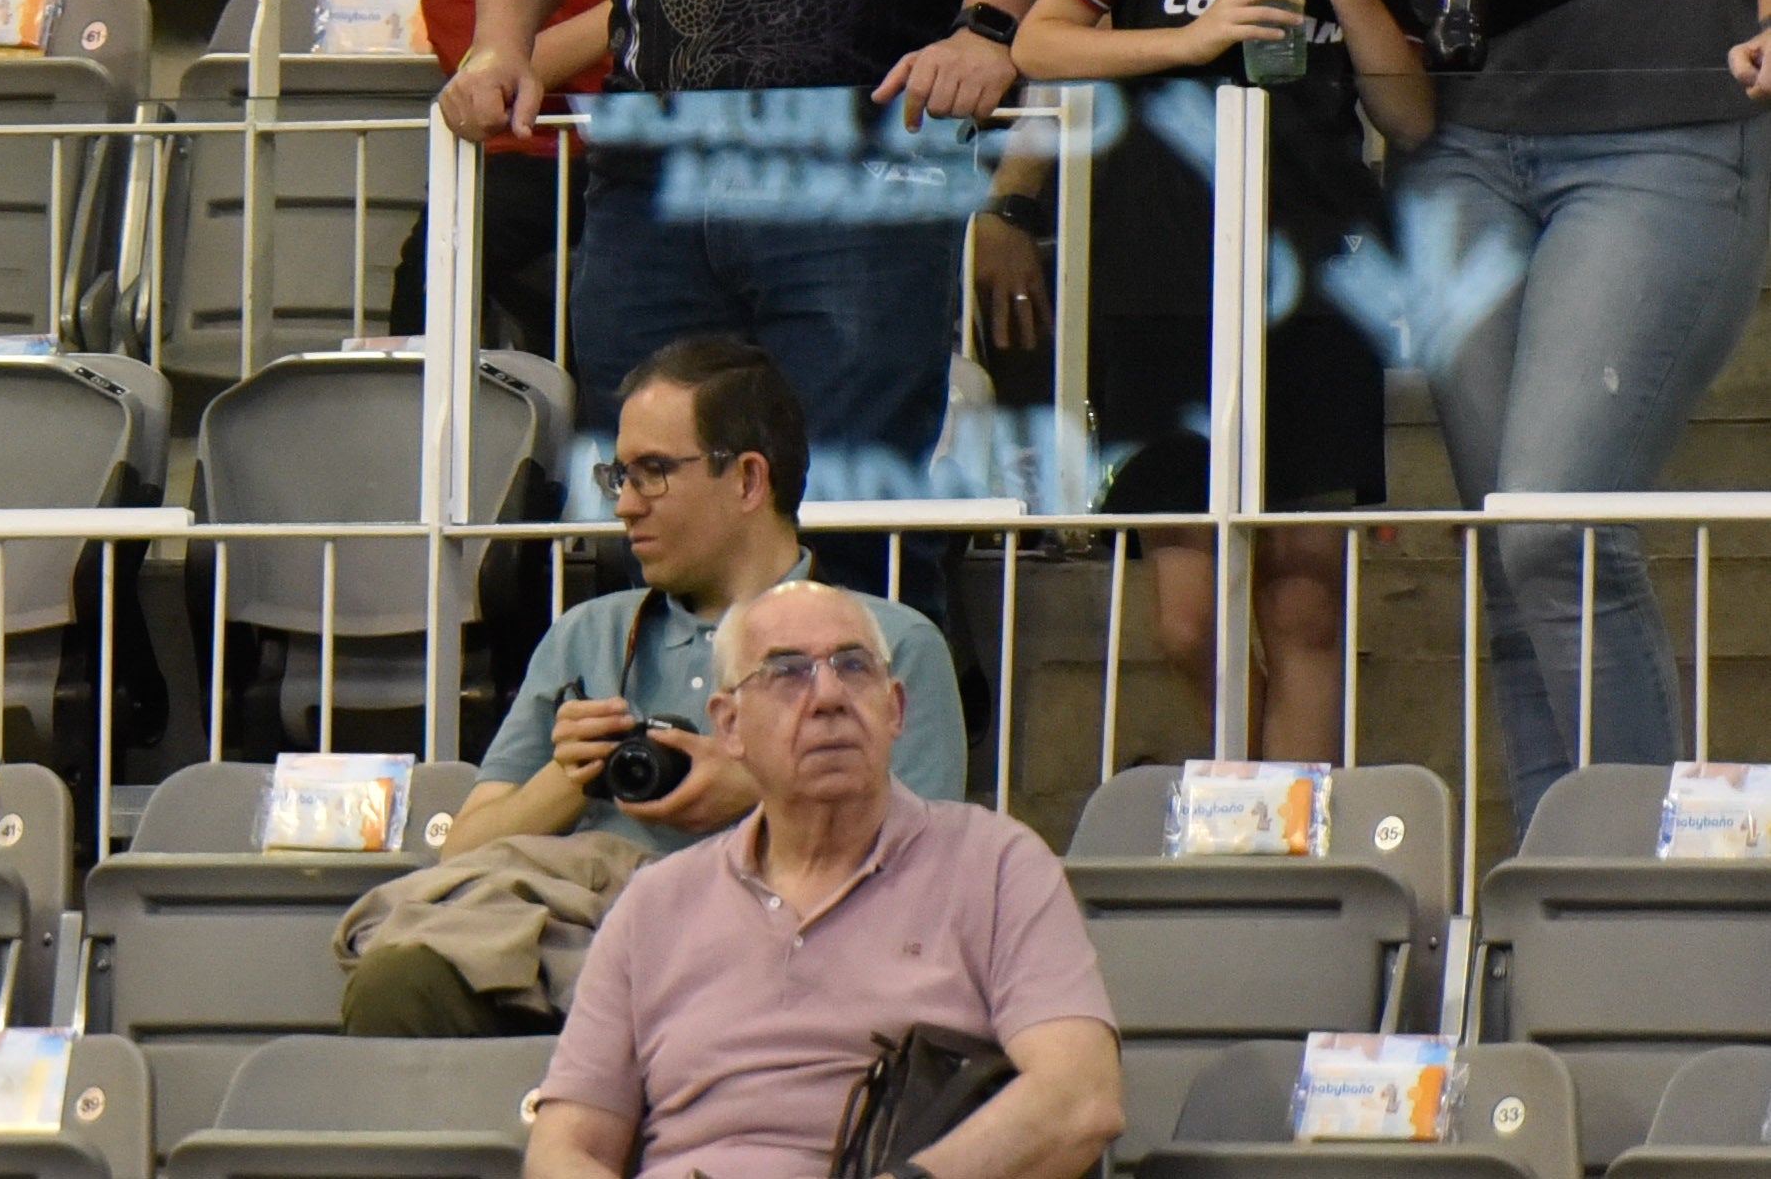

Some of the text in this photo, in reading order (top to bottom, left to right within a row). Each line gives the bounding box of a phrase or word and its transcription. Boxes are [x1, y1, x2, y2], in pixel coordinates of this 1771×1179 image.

[86, 30, 102, 43] 61
[0, 824, 16, 837] 41
[429, 822, 449, 837] 39
[1379, 826, 1399, 841] 35
[1497, 1106, 1520, 1122] 33
